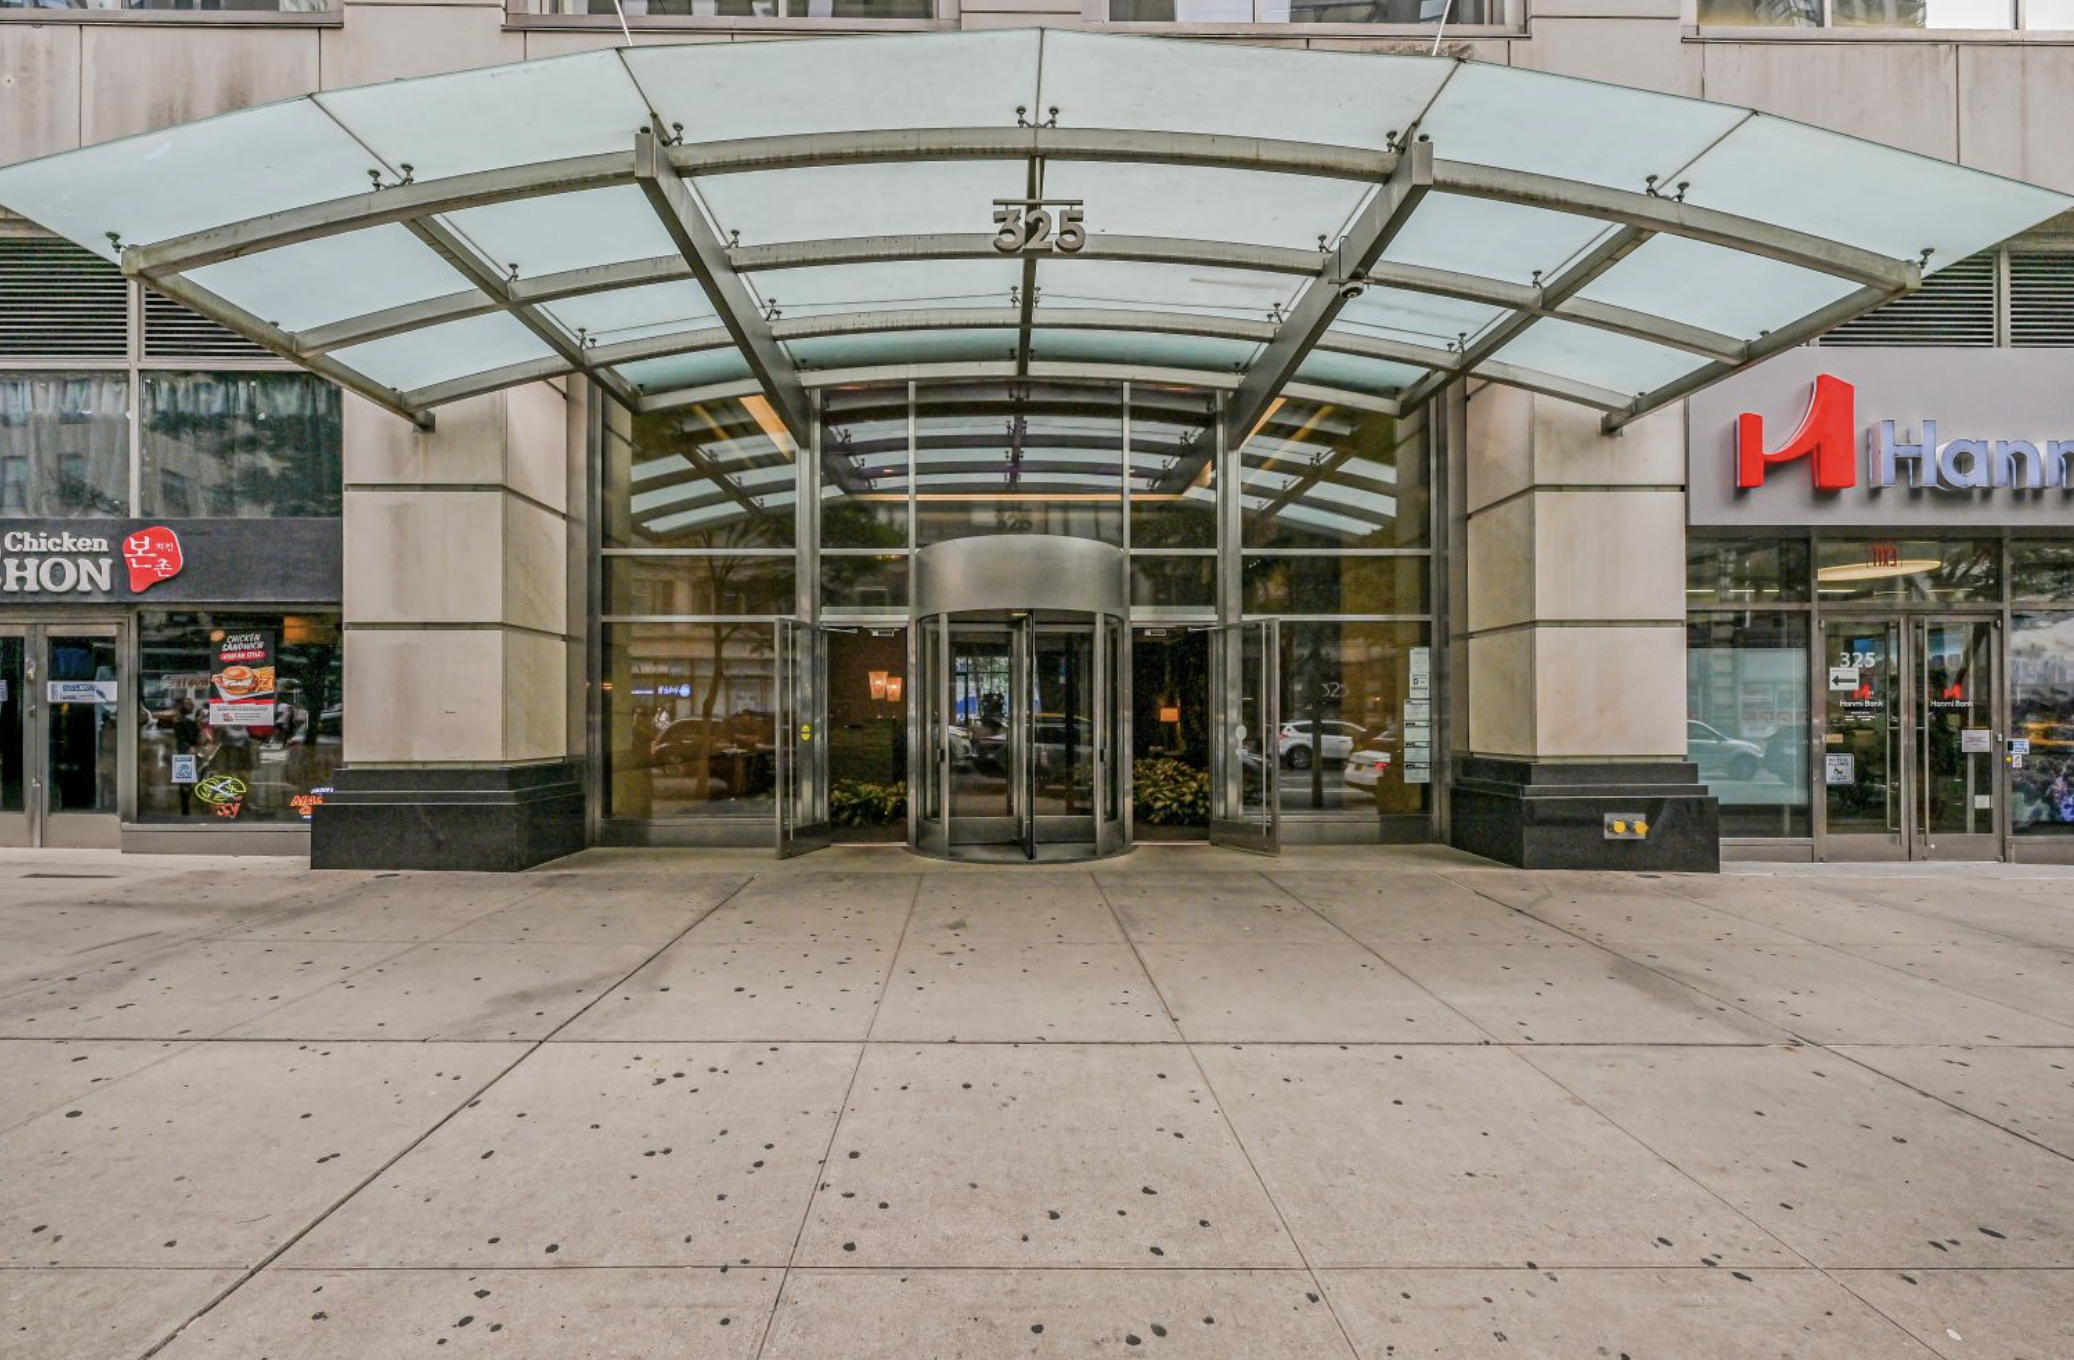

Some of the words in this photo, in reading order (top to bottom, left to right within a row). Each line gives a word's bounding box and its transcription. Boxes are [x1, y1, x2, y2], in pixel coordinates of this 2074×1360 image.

[993, 209, 1086, 252] 325
[4, 531, 109, 552] Chicken
[124, 536, 157, 568] 본
[0, 557, 113, 593] HON
[227, 633, 262, 643] CHICKEN
[1840, 651, 1876, 668] 325
[1320, 682, 1350, 698] 325
